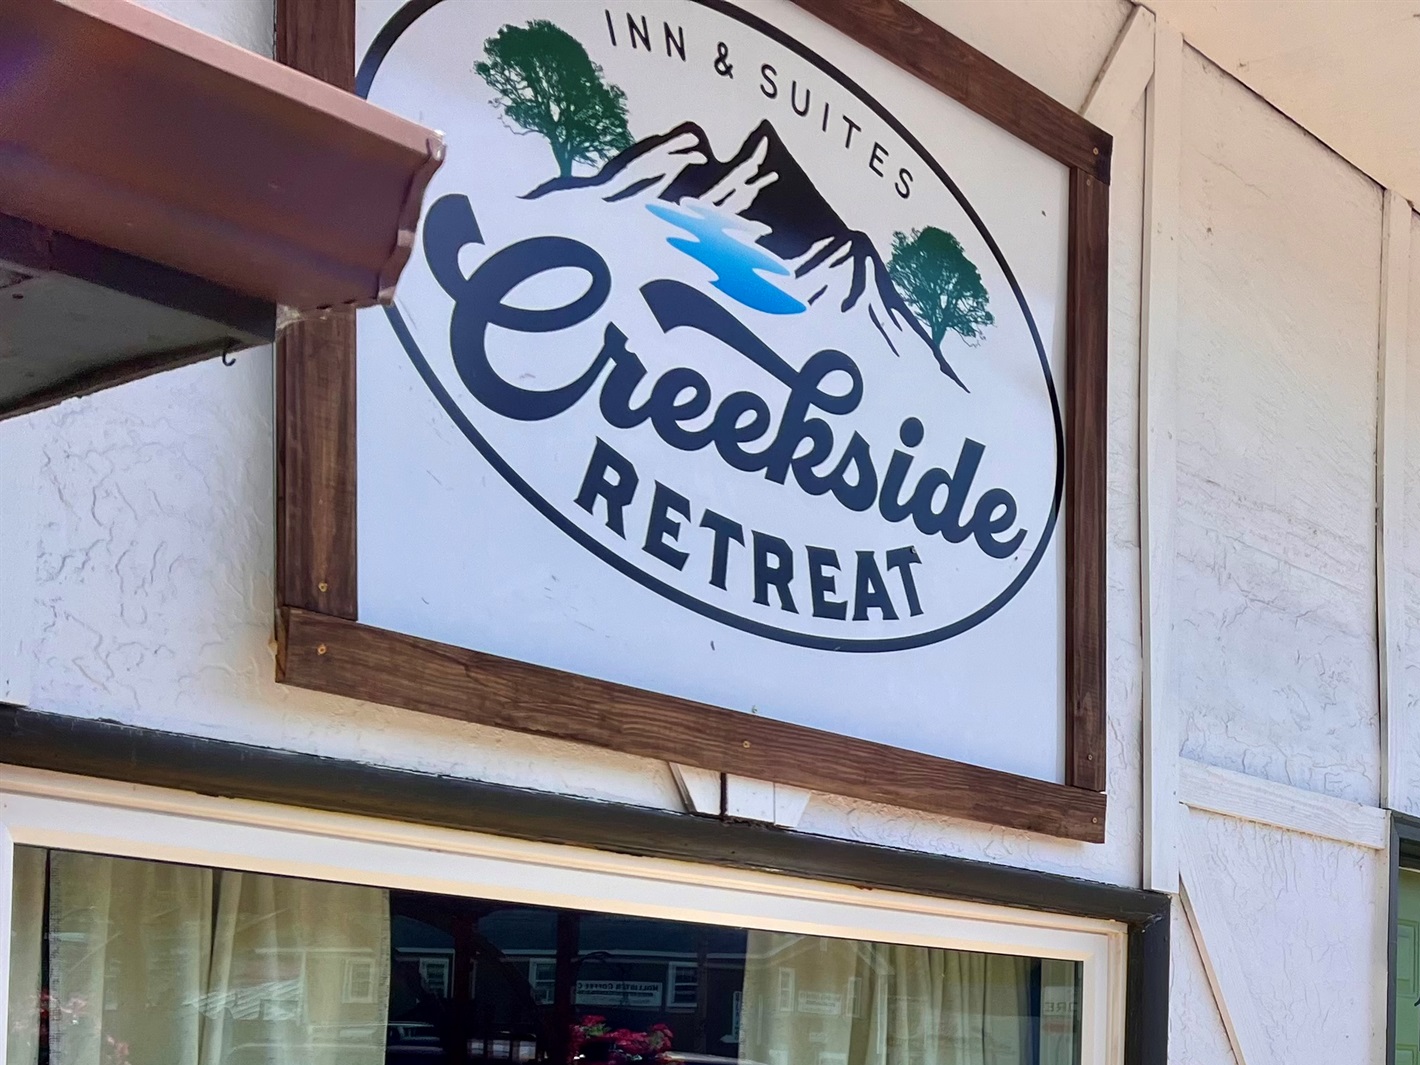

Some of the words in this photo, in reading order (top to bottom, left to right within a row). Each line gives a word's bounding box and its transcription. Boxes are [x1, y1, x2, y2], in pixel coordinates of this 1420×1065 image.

[605, 9, 686, 62] INN
[713, 41, 734, 79] &
[760, 63, 914, 200] SUITES
[423, 194, 1028, 559] Creekside
[573, 435, 925, 622] RETREAT
